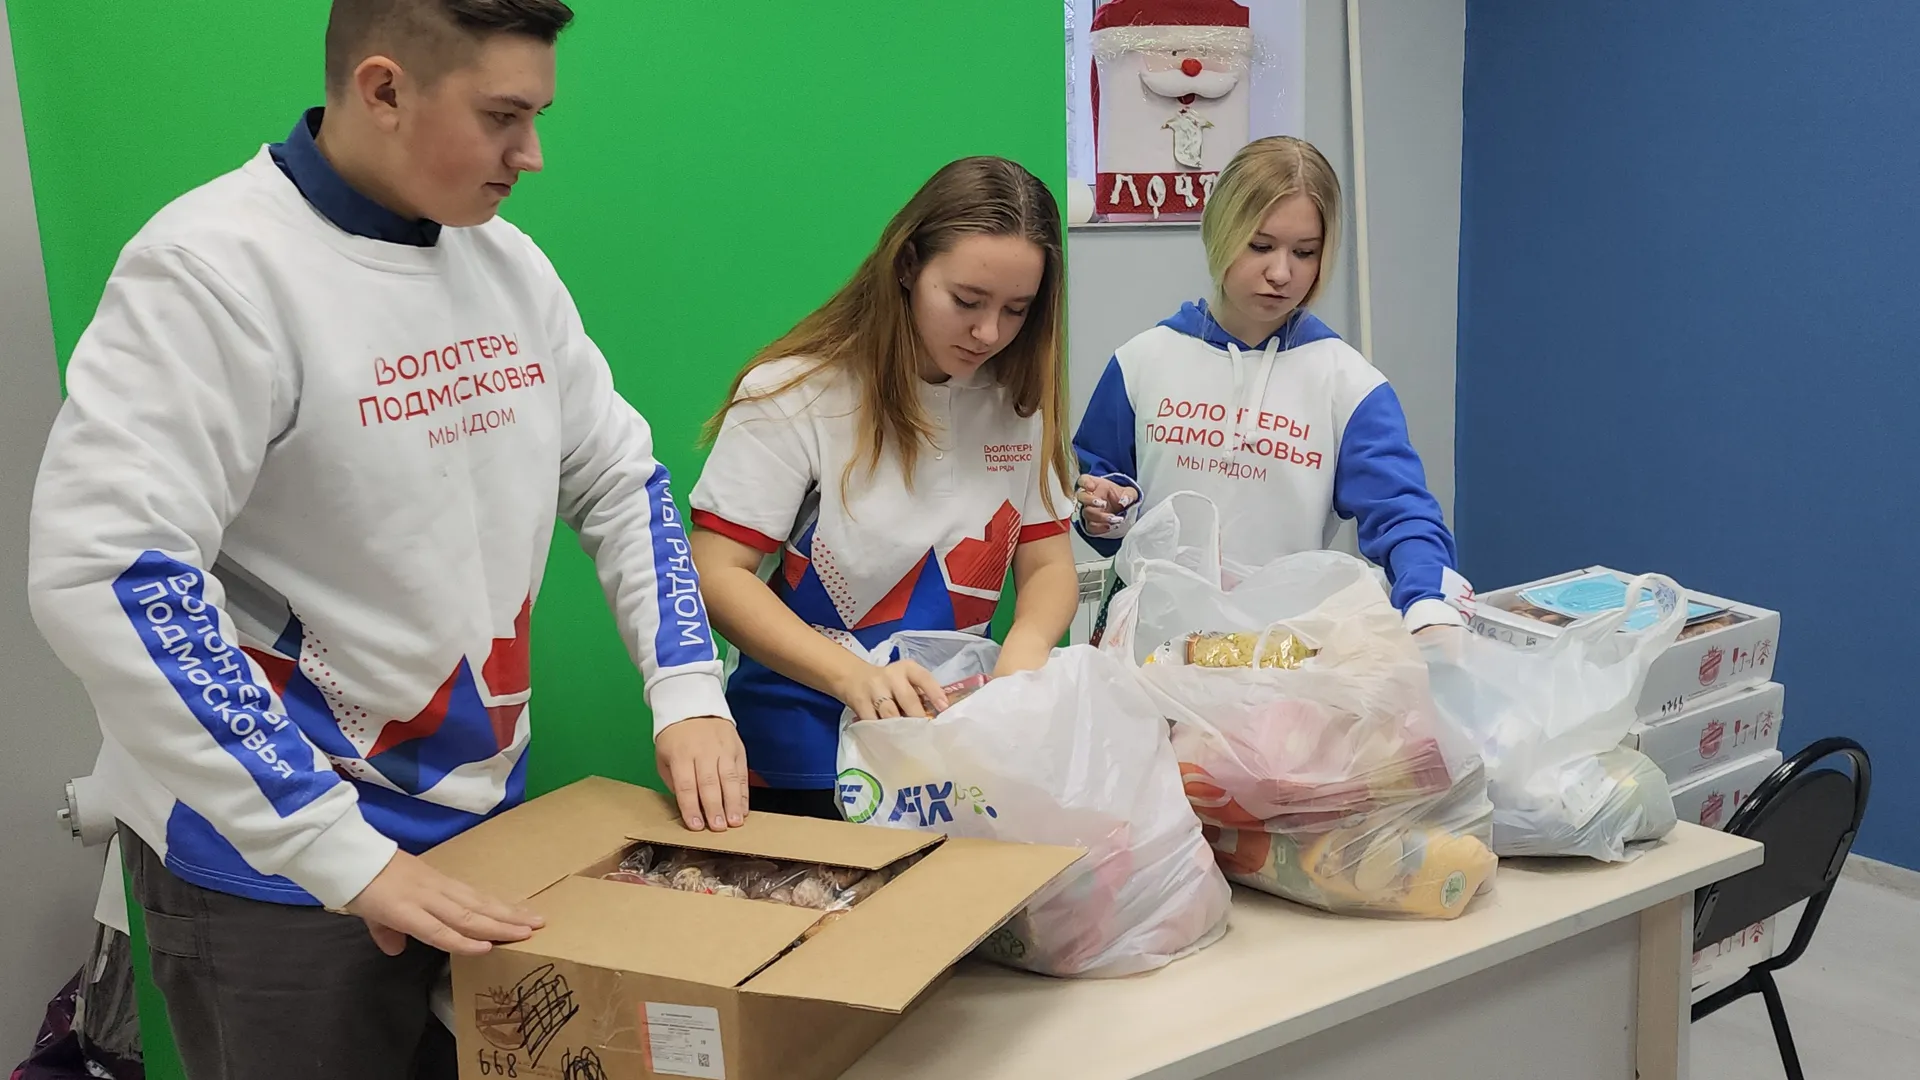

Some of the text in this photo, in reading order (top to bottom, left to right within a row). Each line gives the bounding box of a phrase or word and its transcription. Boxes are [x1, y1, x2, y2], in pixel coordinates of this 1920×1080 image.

[1110, 173, 1218, 220] ПОЧТ
[428, 422, 460, 449] МЫ
[1145, 423, 1323, 470] ПОДМОКОВЬЯ
[1176, 454, 1268, 483] МЫ РЯДОМ
[665, 537, 705, 647] РЯДОМ
[131, 581, 296, 780] ПОДМОСКОВЬЯ
[478, 1048, 518, 1079] 668
